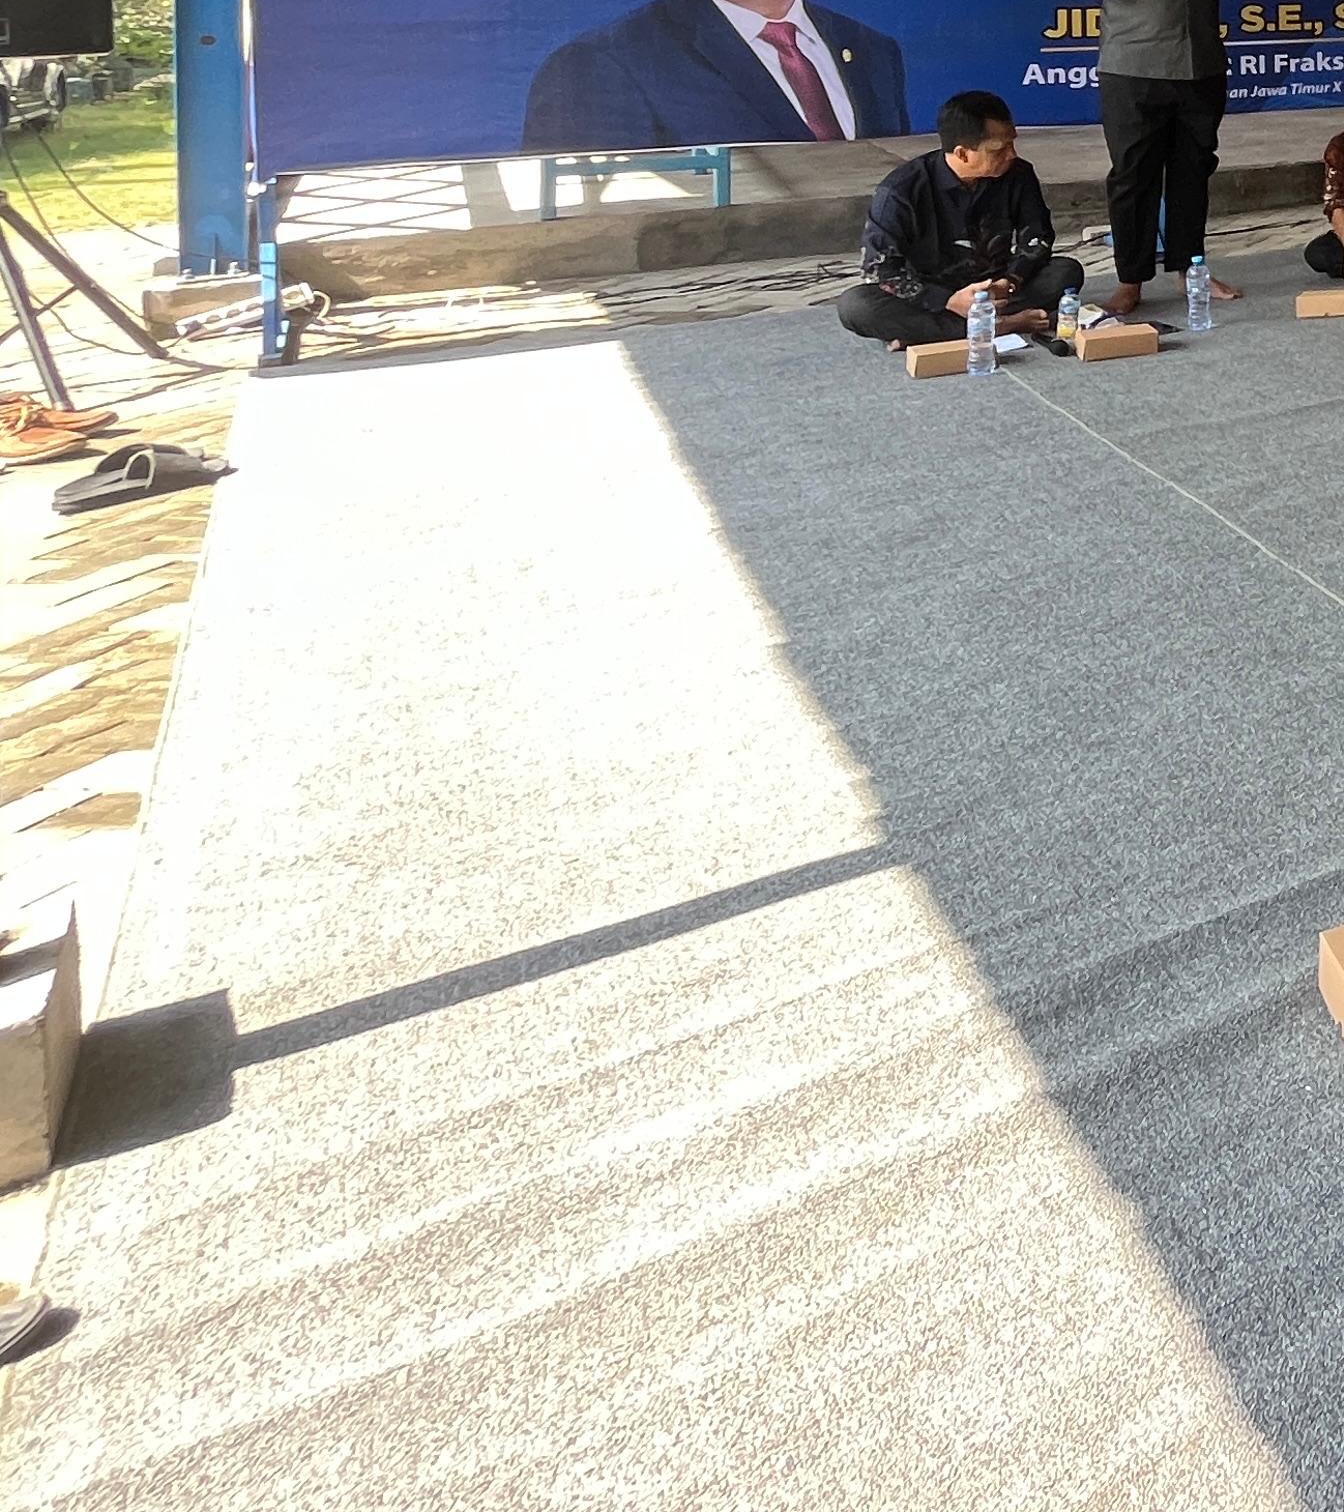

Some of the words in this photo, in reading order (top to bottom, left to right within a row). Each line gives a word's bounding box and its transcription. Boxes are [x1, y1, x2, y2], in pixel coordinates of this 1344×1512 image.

[1240, 4, 1323, 35] S.E.,
[1240, 54, 1266, 76] RI
[1250, 83, 1287, 99] Jawa
[1289, 81, 1331, 96] Timur
[1333, 81, 1342, 93] X
